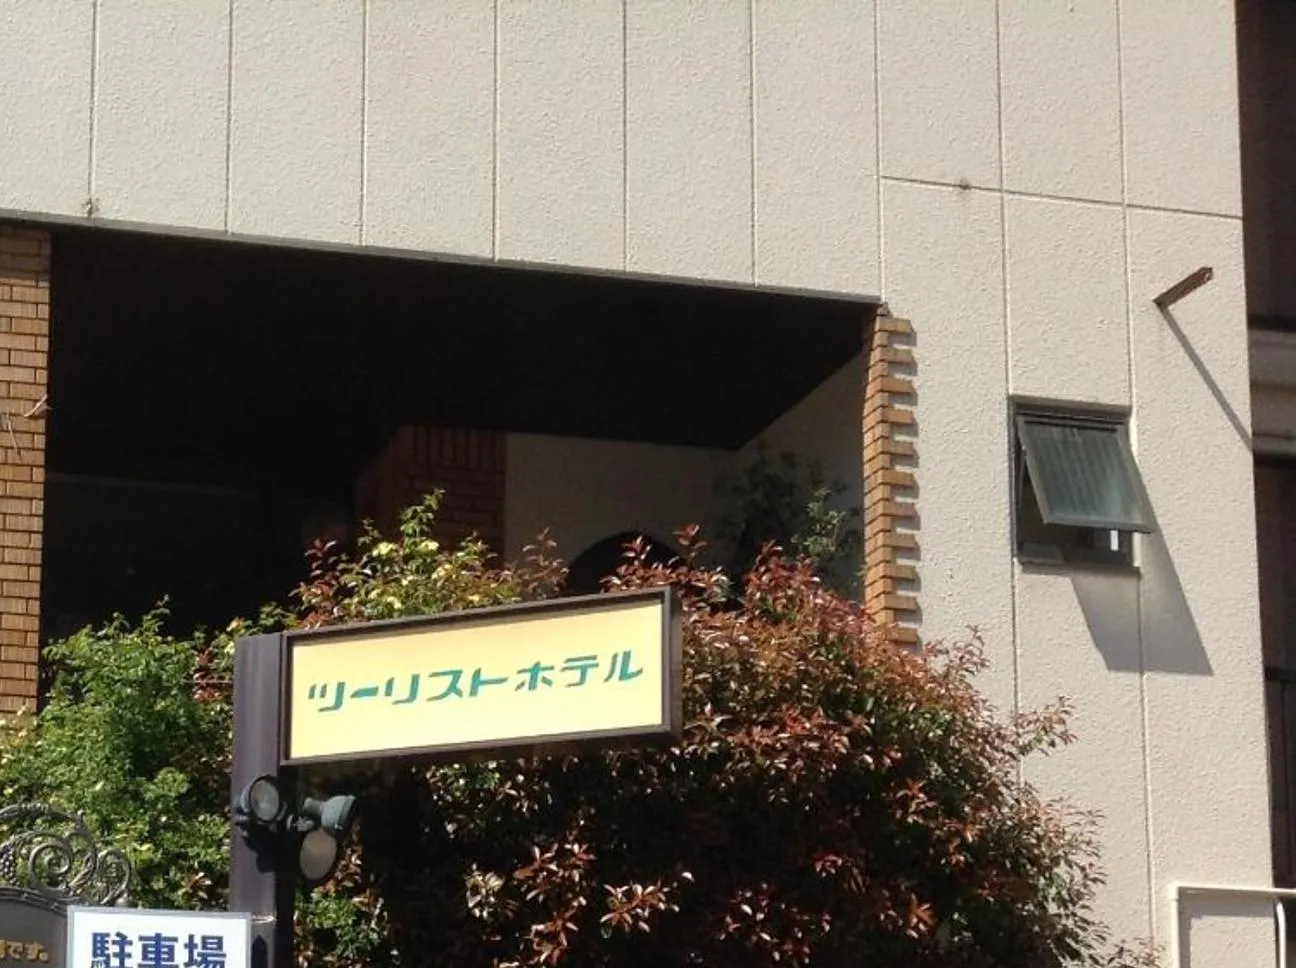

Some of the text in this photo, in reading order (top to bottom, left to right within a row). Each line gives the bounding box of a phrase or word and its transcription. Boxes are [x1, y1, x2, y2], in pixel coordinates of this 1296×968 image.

[307, 650, 644, 713] ツーリストホテル
